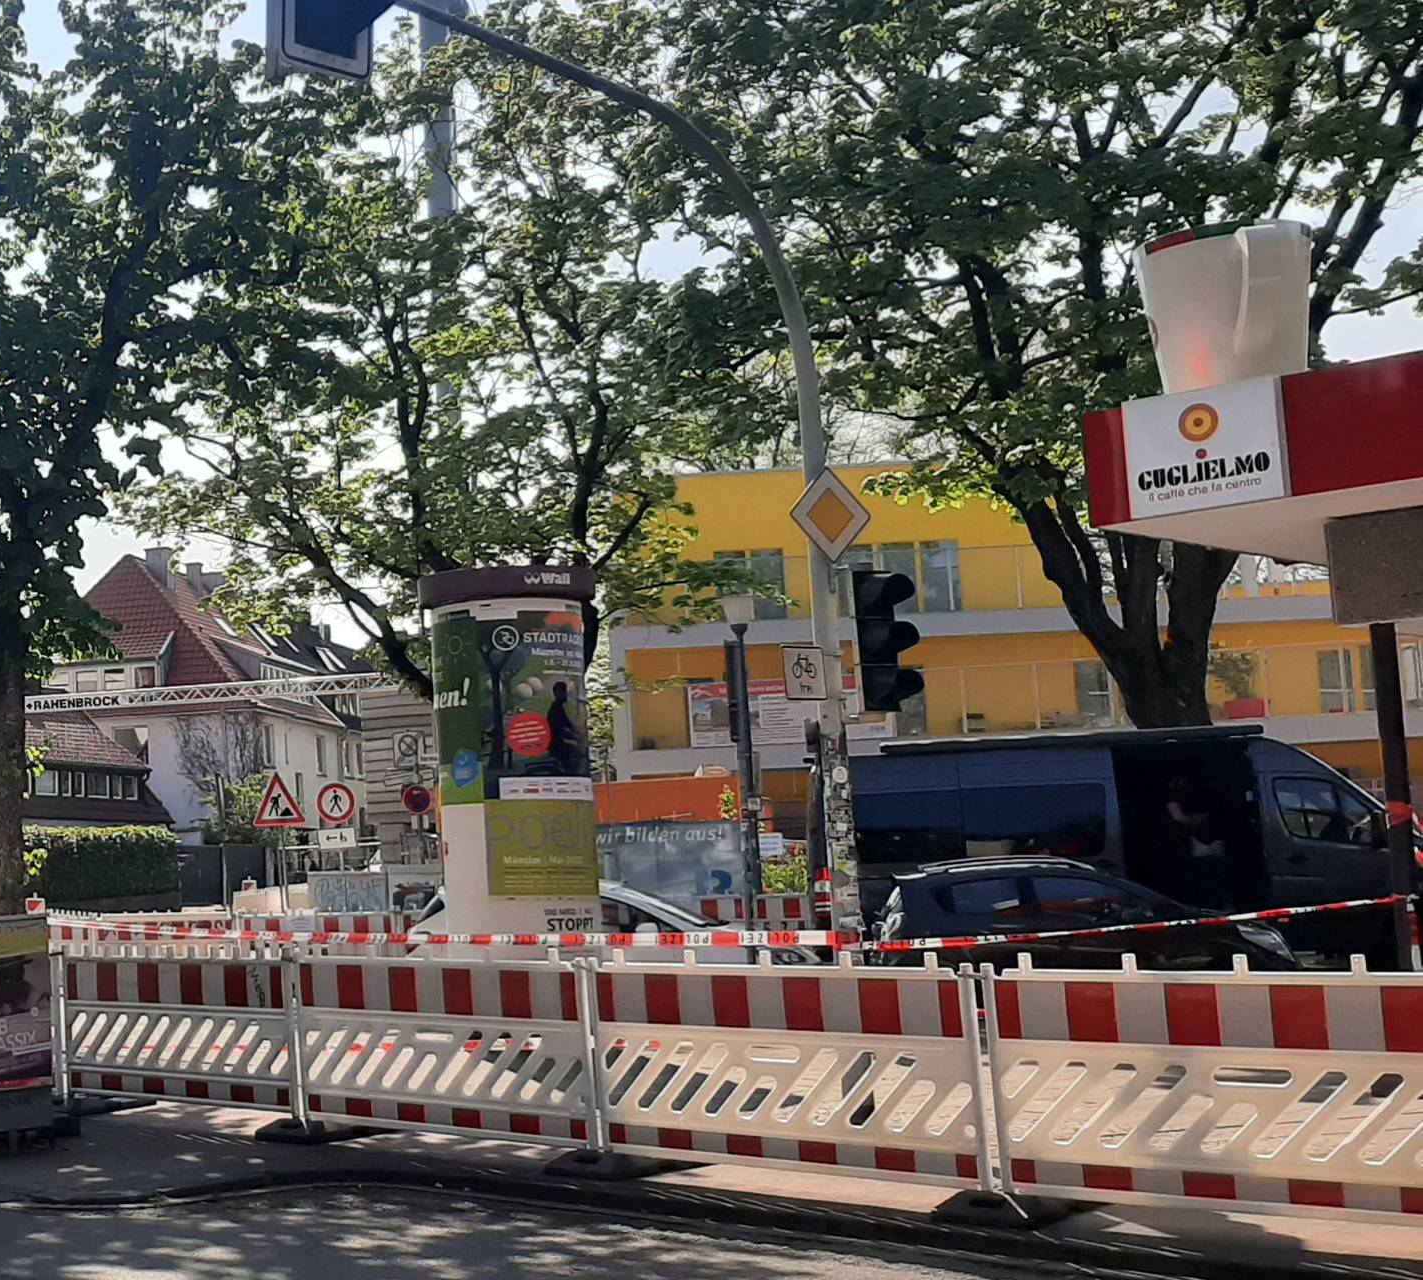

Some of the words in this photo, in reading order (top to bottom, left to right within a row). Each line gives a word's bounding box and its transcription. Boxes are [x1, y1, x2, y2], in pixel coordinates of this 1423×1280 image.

[1138, 450, 1270, 491] GUGLIELMO
[1187, 485, 1208, 496] che
[1211, 482, 1223, 491] fa
[1225, 477, 1262, 490] centro
[541, 572, 570, 584] Wall
[34, 696, 120, 710] RAHENBROCK
[626, 826, 679, 843] bilden
[685, 826, 724, 842] aus!
[740, 933, 800, 944] POLIZEI
